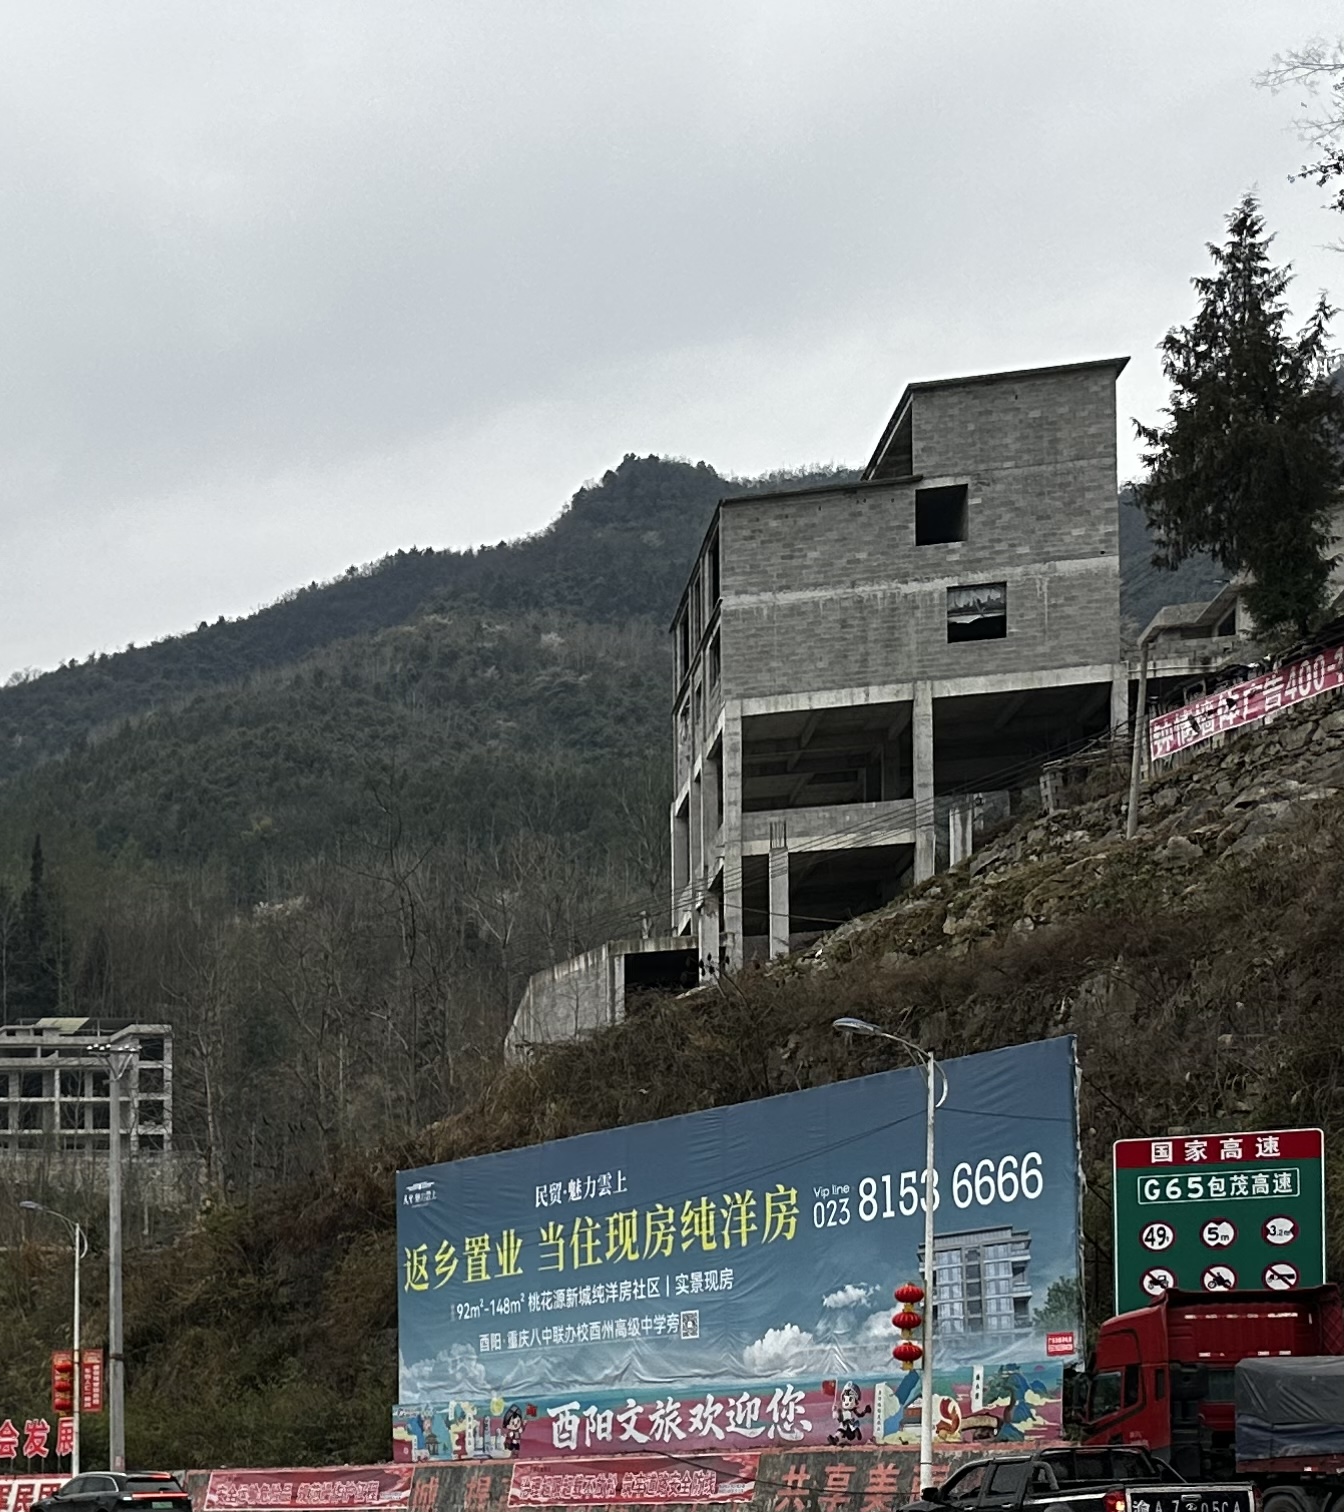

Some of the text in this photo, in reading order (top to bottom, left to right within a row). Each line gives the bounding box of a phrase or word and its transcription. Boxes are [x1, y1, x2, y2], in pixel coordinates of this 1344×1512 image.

[1150, 1136, 1281, 1163] 国家高速
[813, 1184, 850, 1199] Vip line
[858, 1151, 1043, 1222] 8153 6666
[1143, 1172, 1293, 1201] G65包茂高速
[813, 1198, 851, 1228] 023
[403, 1184, 800, 1293] 返乡置业 当住现房纯洋房
[1207, 1227, 1229, 1242] 5m
[675, 1267, 734, 1293] 实景现房
[548, 1383, 814, 1451] 酉阳文旅欢迎您
